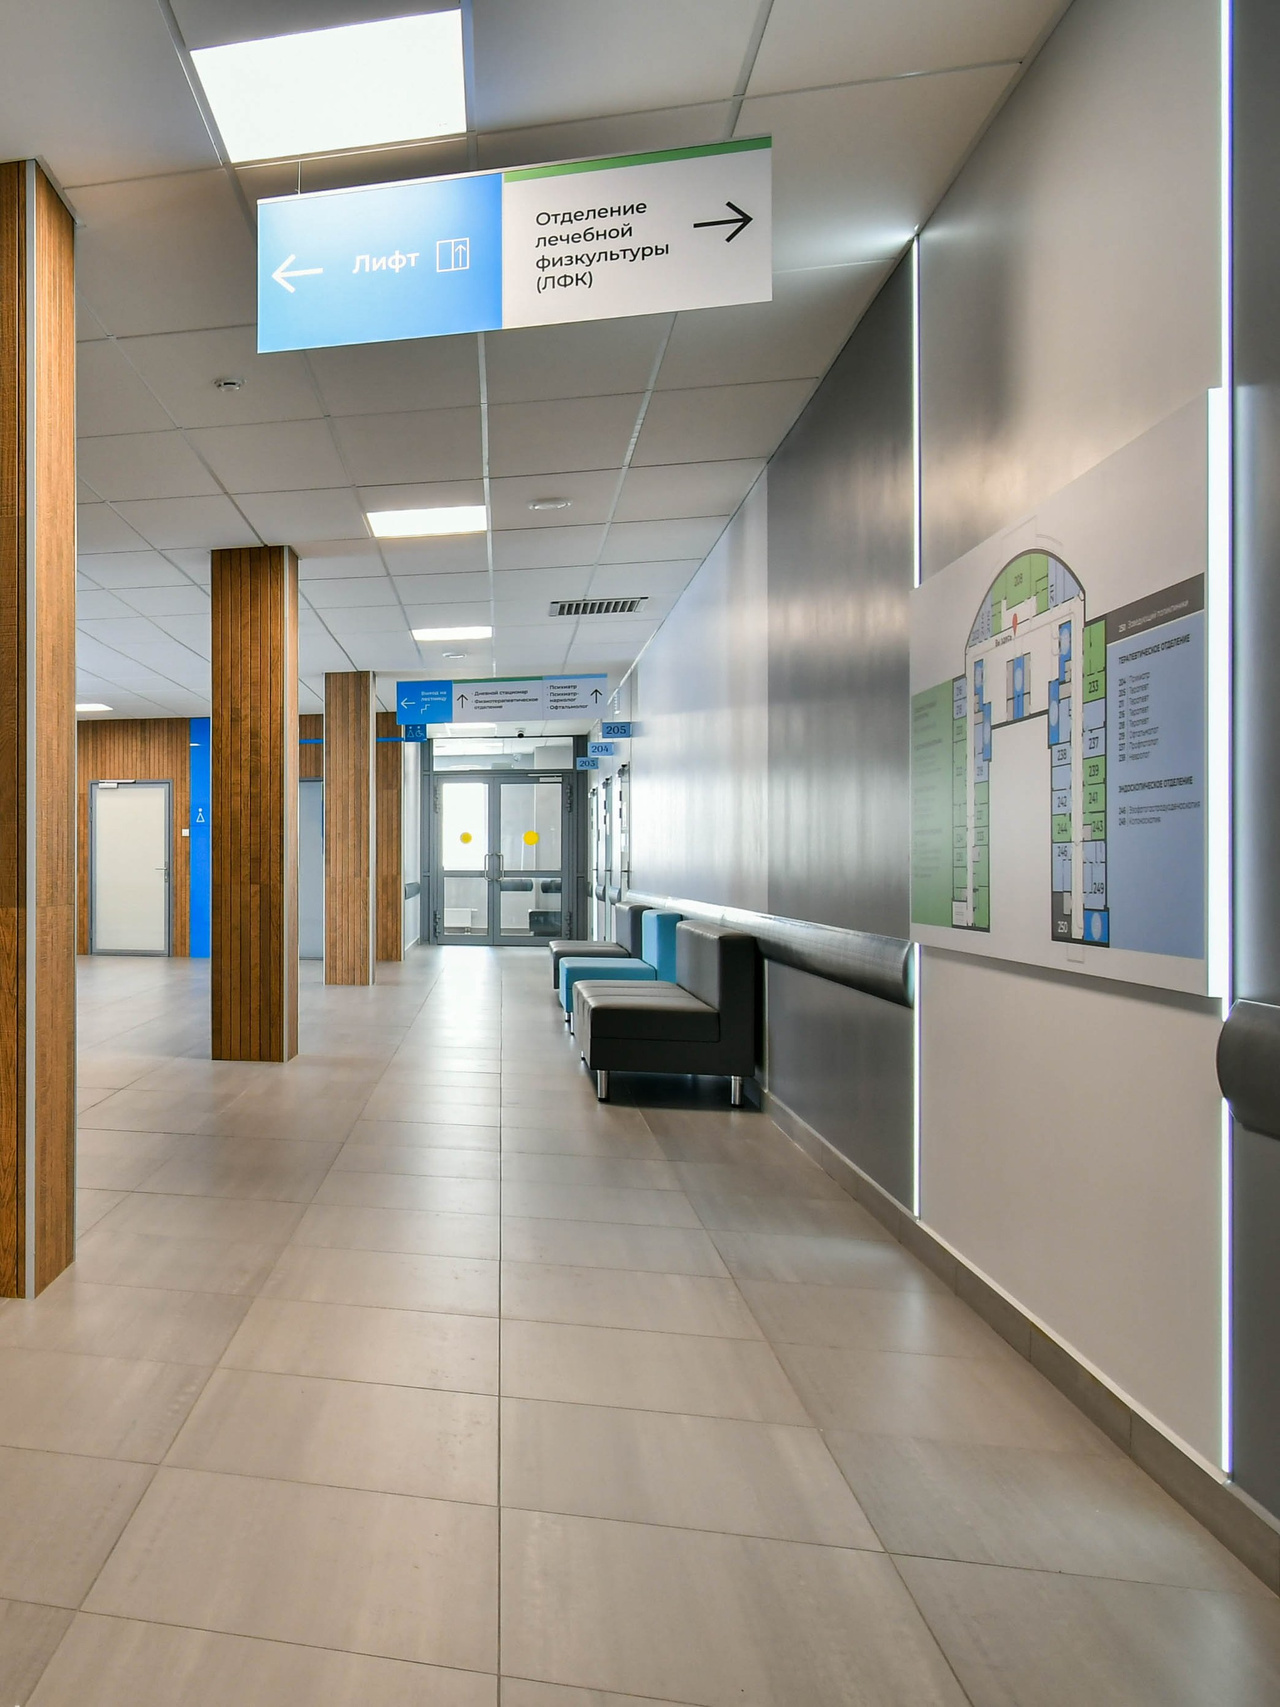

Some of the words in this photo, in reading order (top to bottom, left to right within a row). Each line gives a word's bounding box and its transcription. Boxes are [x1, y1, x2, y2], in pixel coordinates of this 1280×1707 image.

[535, 202, 647, 227] Отделение
[535, 223, 633, 248] лечебной
[352, 250, 420, 275] Лифт
[535, 244, 670, 272] физкультуры
[536, 271, 593, 294] (ЛФК)
[1118, 643, 1160, 664] ТЕРАПЕВТИЧЕСКОЕ
[1161, 633, 1191, 651] ОТДЕЛЕНИЕ
[1089, 680, 1099, 693] 233
[606, 725, 626, 735] 205
[591, 745, 609, 753] 204
[1089, 737, 1099, 750] 237
[579, 760, 596, 768] 203
[1089, 765, 1099, 777] 239
[1118, 780, 1163, 793] ЭНДОСКОПИЧЕСКОЕ
[1164, 775, 1193, 787] ОТДЕЛЕНИЕ
[1094, 883, 1105, 894] 249
[1057, 921, 1068, 933] 250
